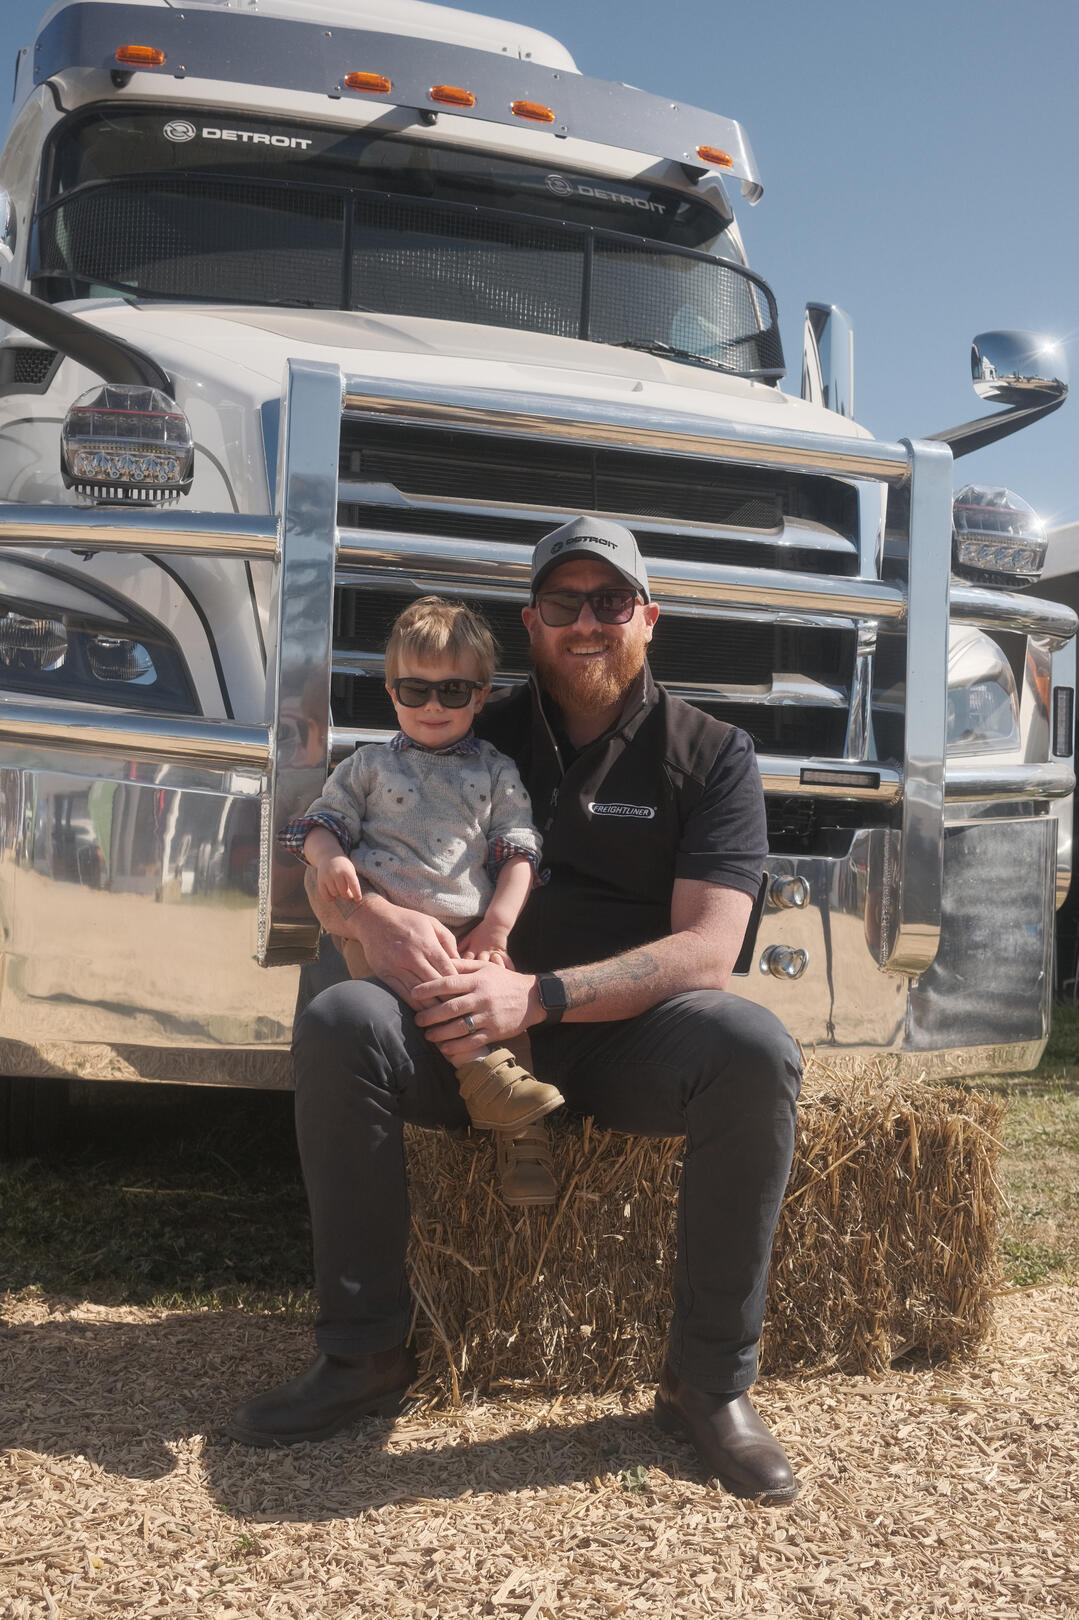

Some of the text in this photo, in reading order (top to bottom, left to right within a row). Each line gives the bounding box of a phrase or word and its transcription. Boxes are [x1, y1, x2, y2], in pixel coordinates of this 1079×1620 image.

[202, 127, 313, 150] DETROIT
[576, 185, 666, 215] DETROIT
[565, 535, 618, 550] DETROIT
[593, 805, 650, 816] FREIGHTLINER
